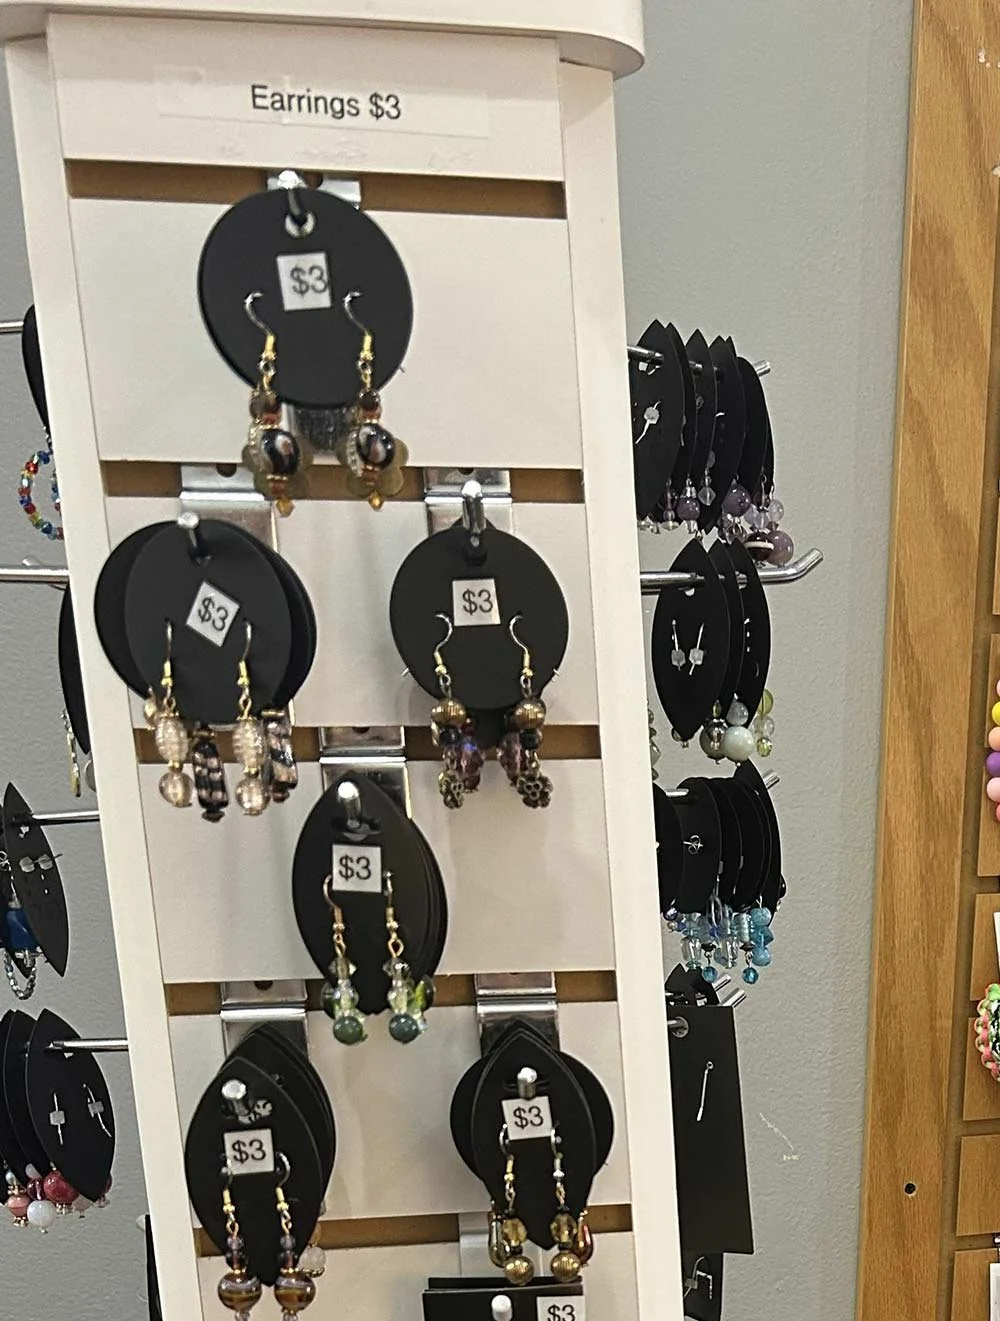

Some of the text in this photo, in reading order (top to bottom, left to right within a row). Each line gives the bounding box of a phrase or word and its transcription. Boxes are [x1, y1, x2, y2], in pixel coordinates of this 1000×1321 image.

[251, 84, 402, 120] Earrings $3
[290, 265, 328, 299] $3
[198, 597, 229, 632] $3
[462, 589, 494, 615] $3
[339, 854, 371, 882] $3
[513, 1105, 544, 1130] $3
[232, 1138, 266, 1164] $3
